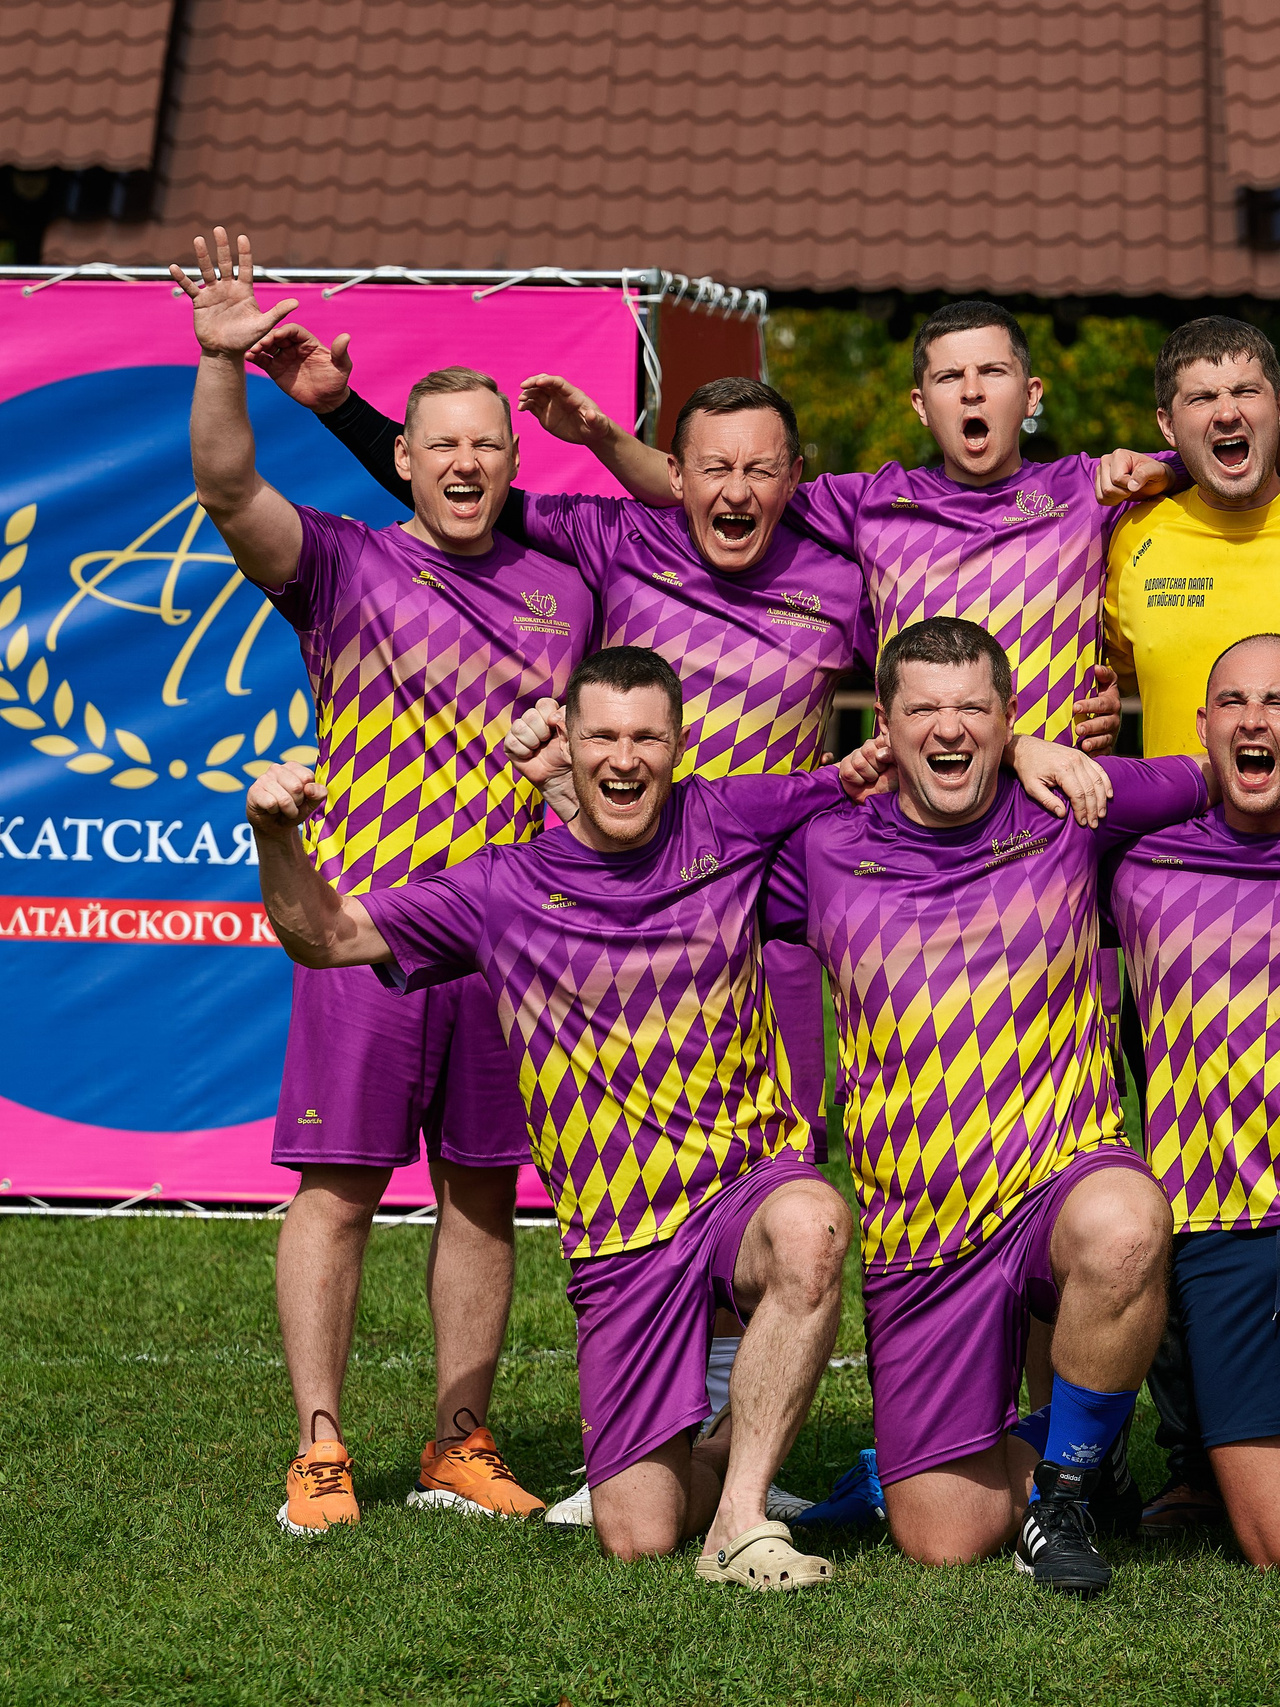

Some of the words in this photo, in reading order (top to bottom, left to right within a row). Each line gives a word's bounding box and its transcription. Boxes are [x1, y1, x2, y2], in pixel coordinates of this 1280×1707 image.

[412, 577, 445, 589] SportLife
[652, 572, 683, 587] SportLife
[1144, 577, 1187, 591] АДВОКАТСКАЯ
[1187, 577, 1214, 590] ПАЛАТА
[1147, 591, 1186, 608] АЛТАЙСКОГО
[1186, 594, 1205, 608] КРАЯ
[853, 866, 887, 876] SportLife
[549, 893, 568, 903] SL
[541, 900, 577, 910] SportLife
[0, 902, 243, 942] ЛТАЙСКОГО
[305, 1109, 318, 1117] SL
[1059, 1473, 1082, 1482] adidas
